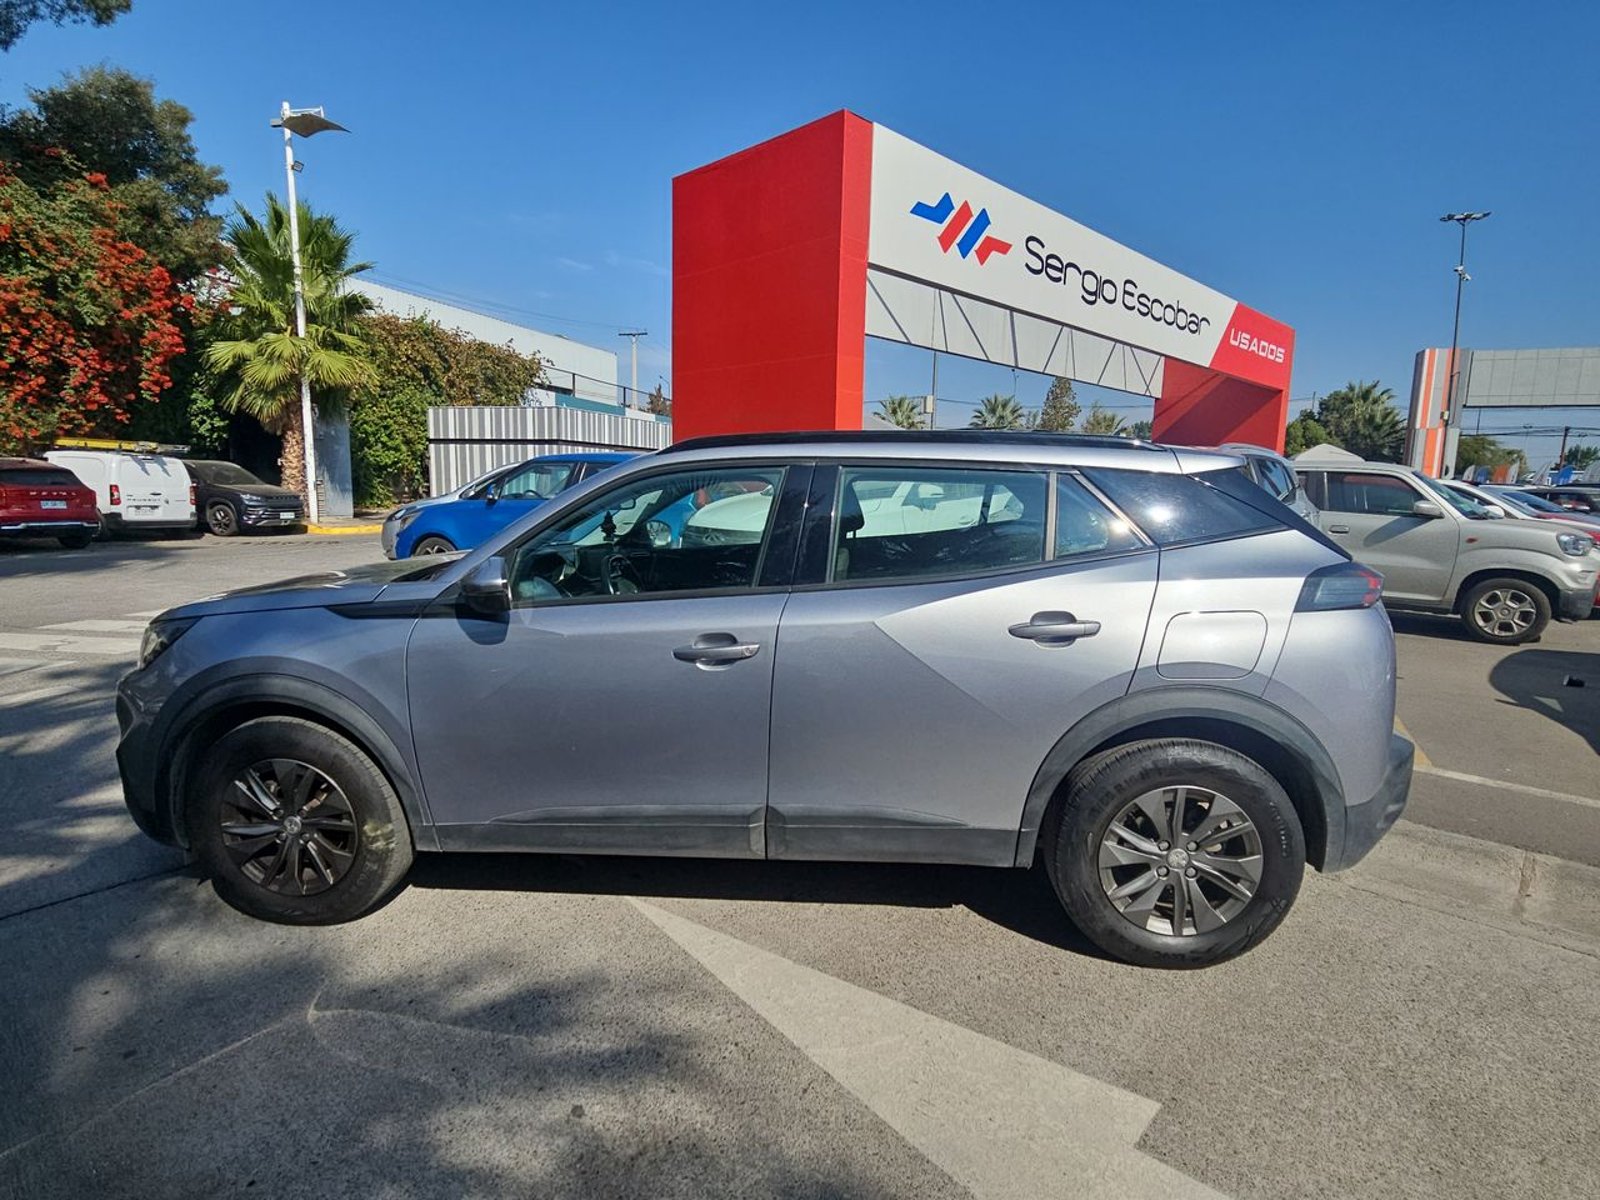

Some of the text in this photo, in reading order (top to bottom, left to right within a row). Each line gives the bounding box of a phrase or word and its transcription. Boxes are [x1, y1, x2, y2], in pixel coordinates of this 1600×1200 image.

[1025, 235, 1211, 336] Sergio Escobar
[1229, 328, 1286, 364] USADOS
